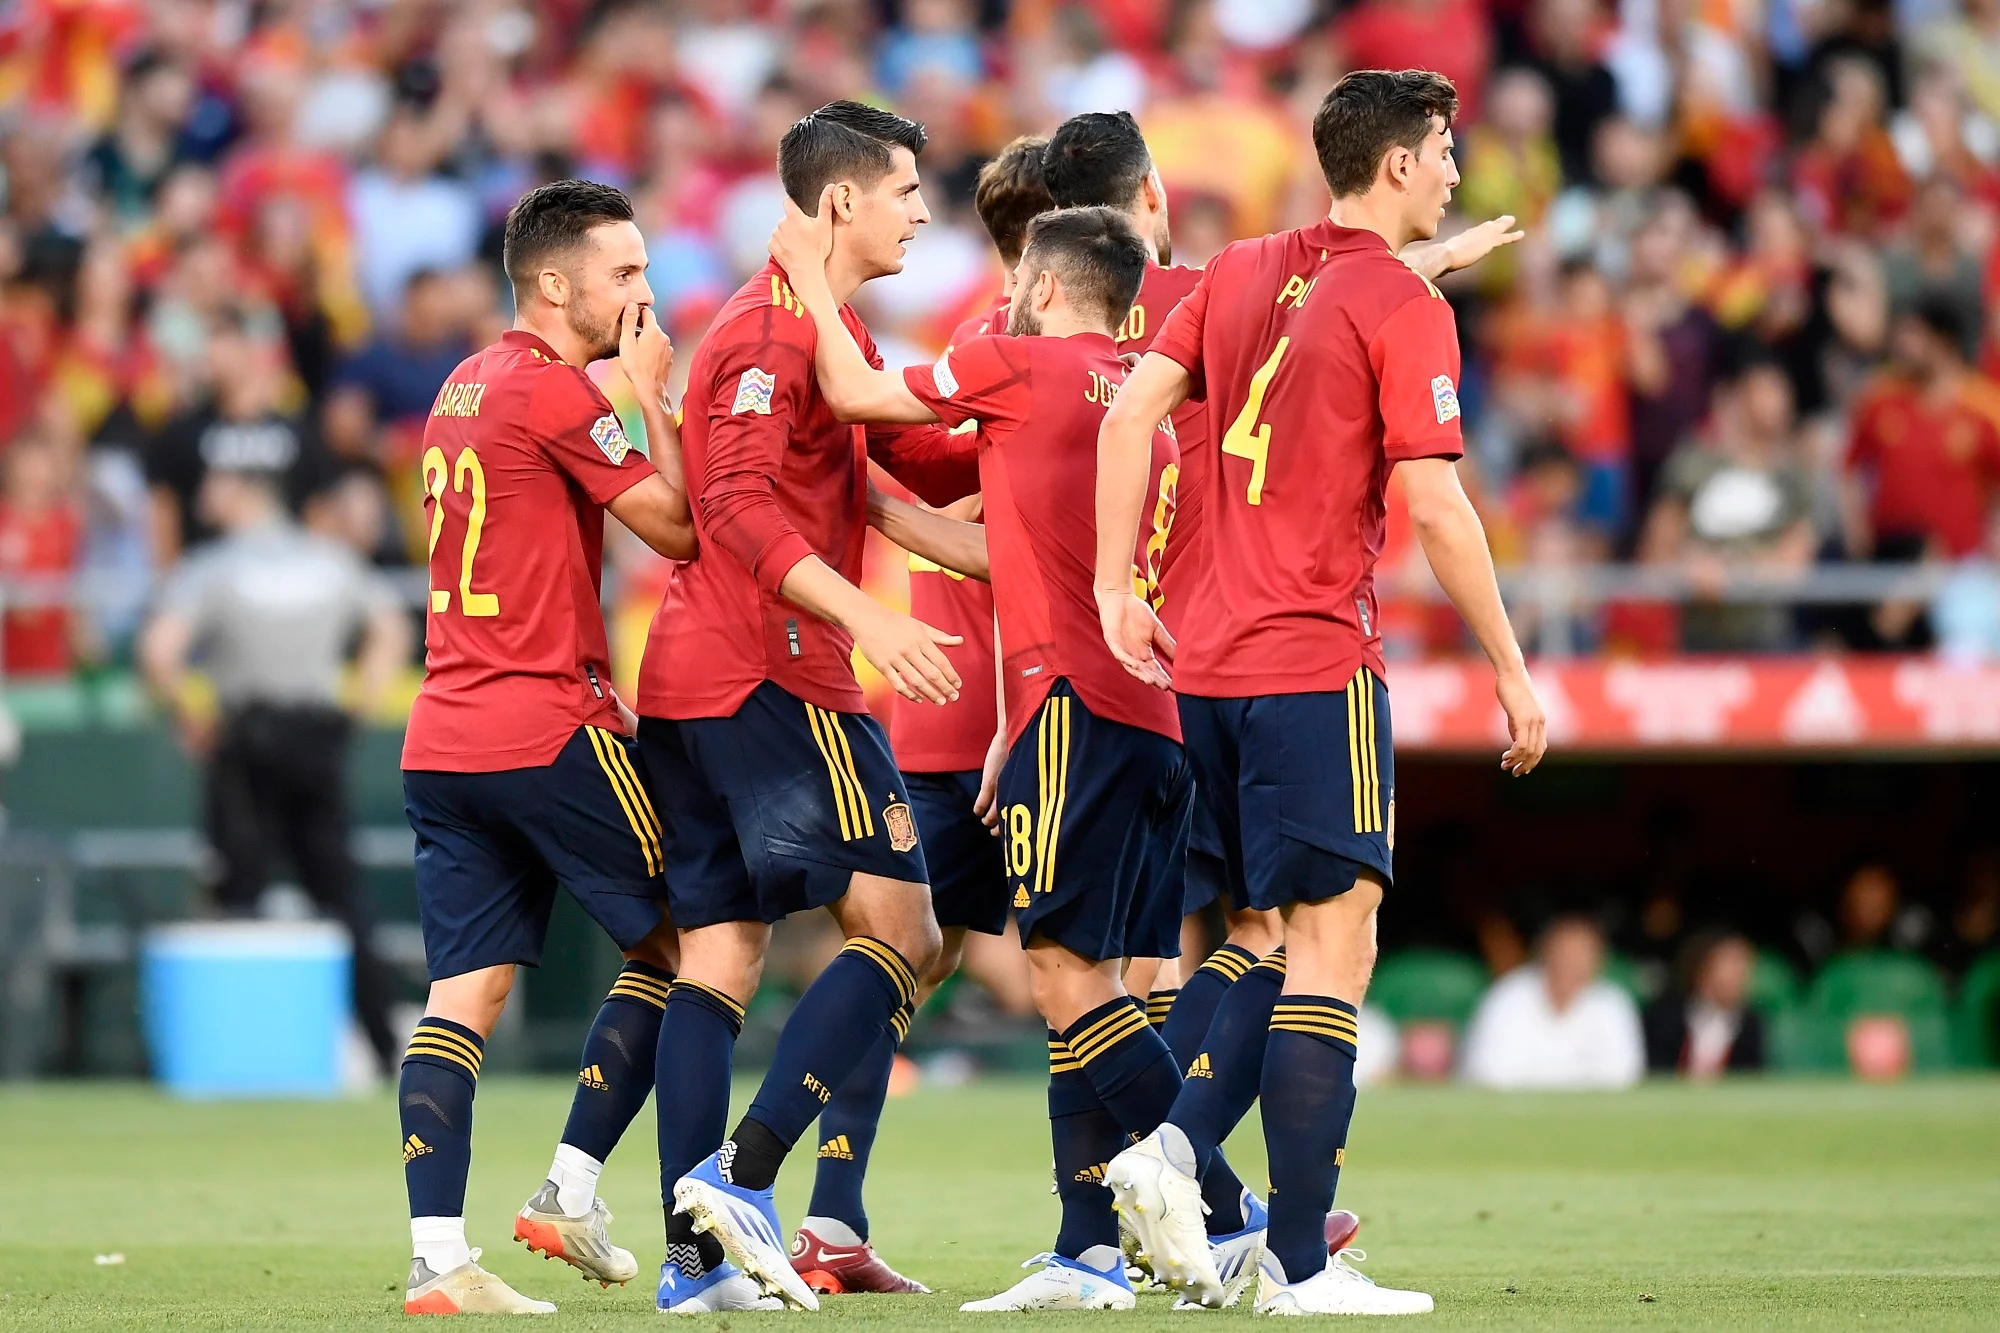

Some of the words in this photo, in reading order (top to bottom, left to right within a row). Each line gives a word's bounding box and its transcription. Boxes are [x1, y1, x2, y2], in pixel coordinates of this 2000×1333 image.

[1222, 336, 1290, 506] 4
[422, 446, 500, 617] 22
[817, 1151, 854, 1161] adidas
